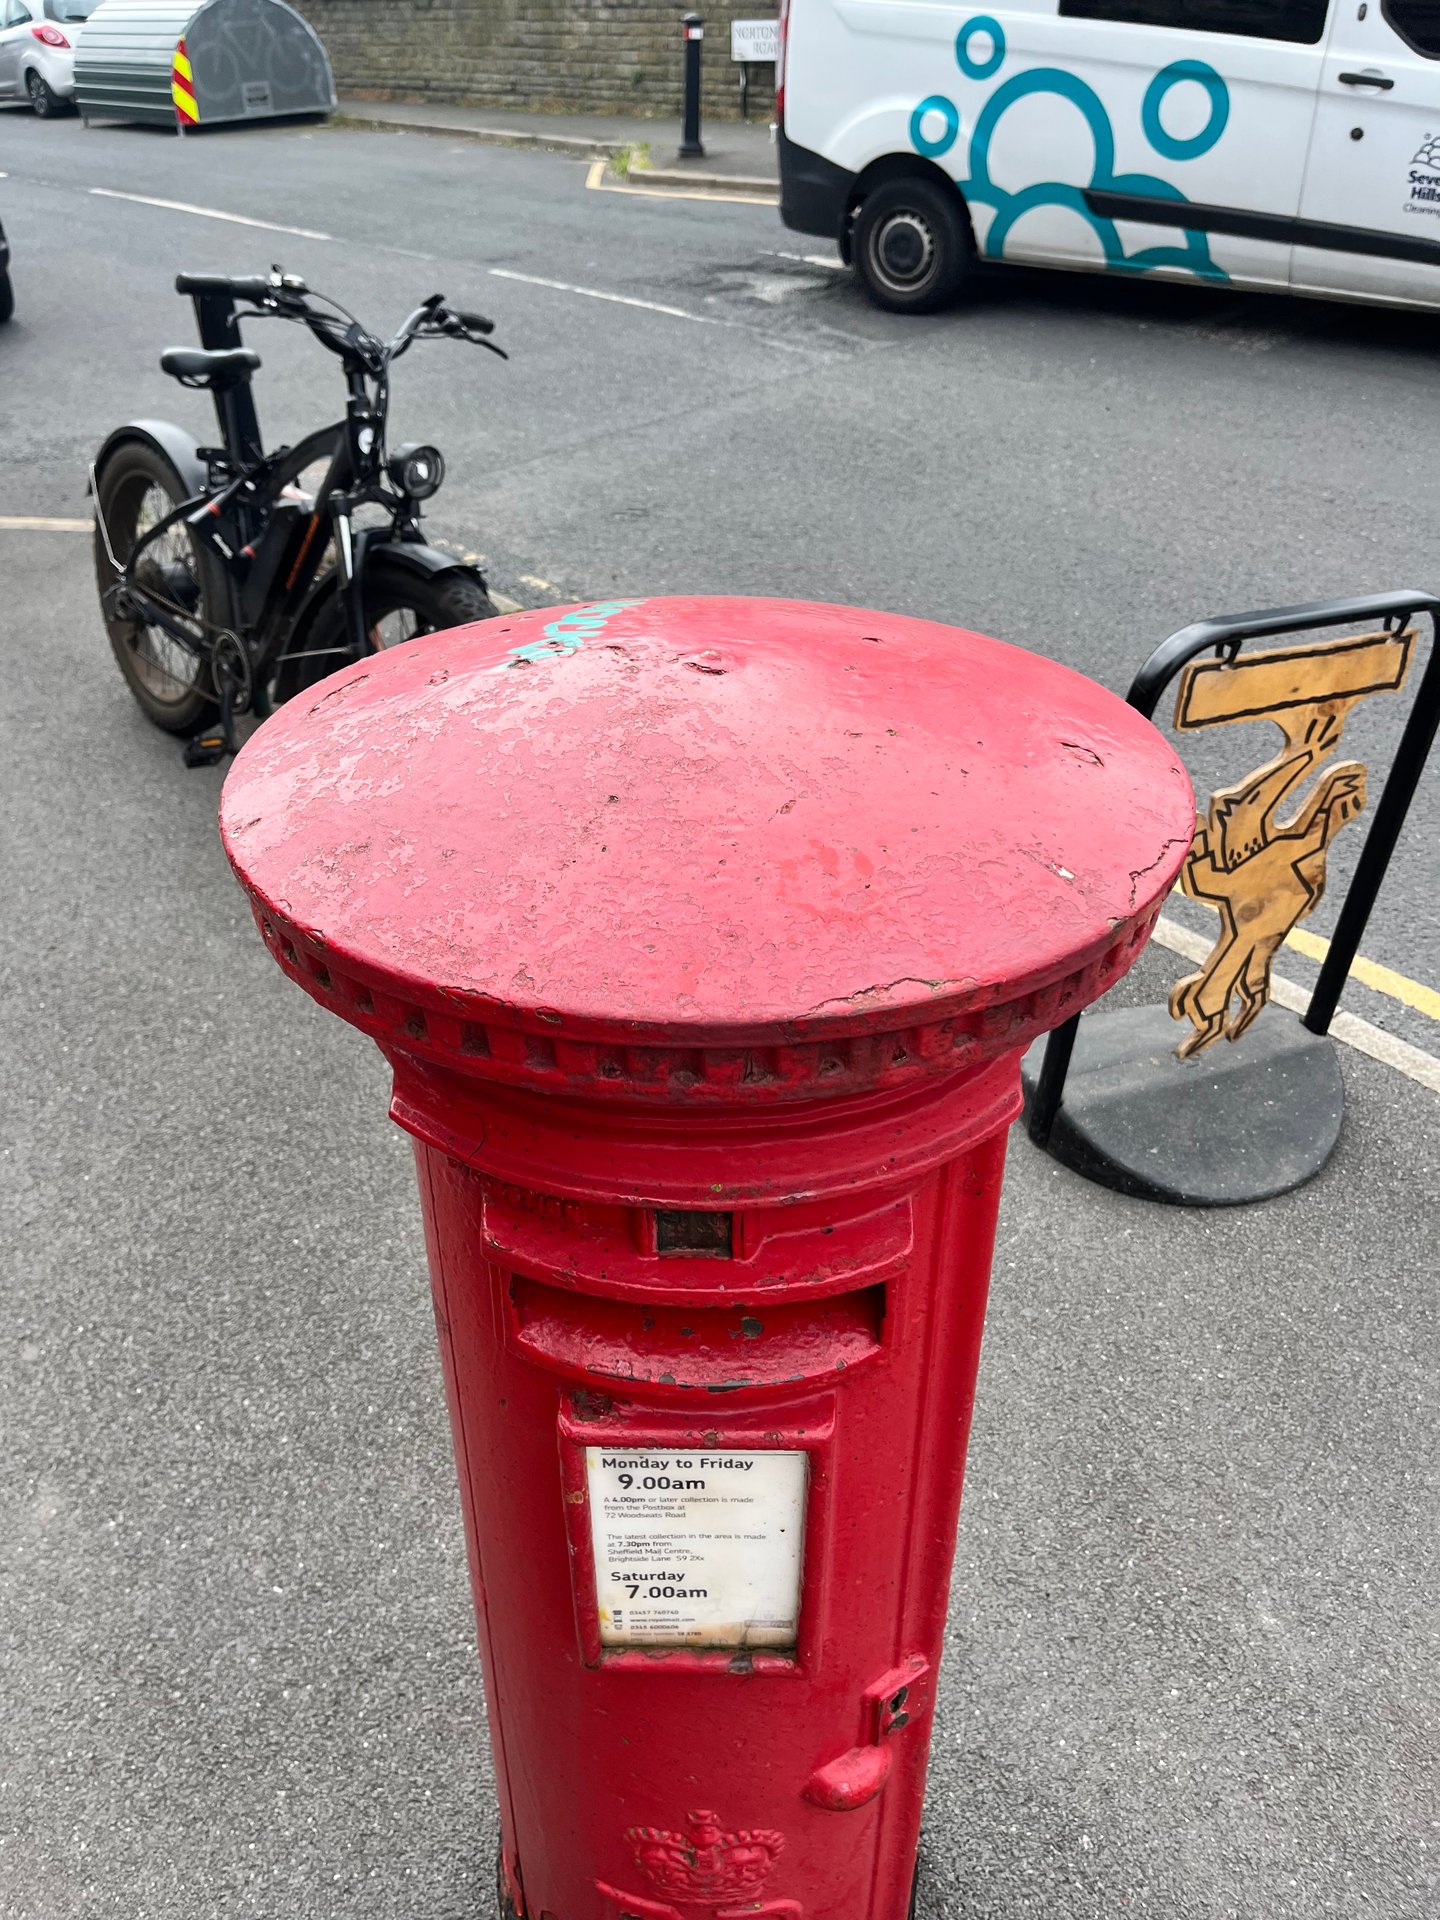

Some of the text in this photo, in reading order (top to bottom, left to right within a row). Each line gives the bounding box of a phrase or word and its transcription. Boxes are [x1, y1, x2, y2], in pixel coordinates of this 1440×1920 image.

[1407, 170, 1440, 187] Seve
[602, 1458, 753, 1471] Monday to Friday
[618, 1474, 706, 1489] 9.00am
[611, 1572, 685, 1582] Saturday
[625, 1585, 708, 1598] 7.00am
